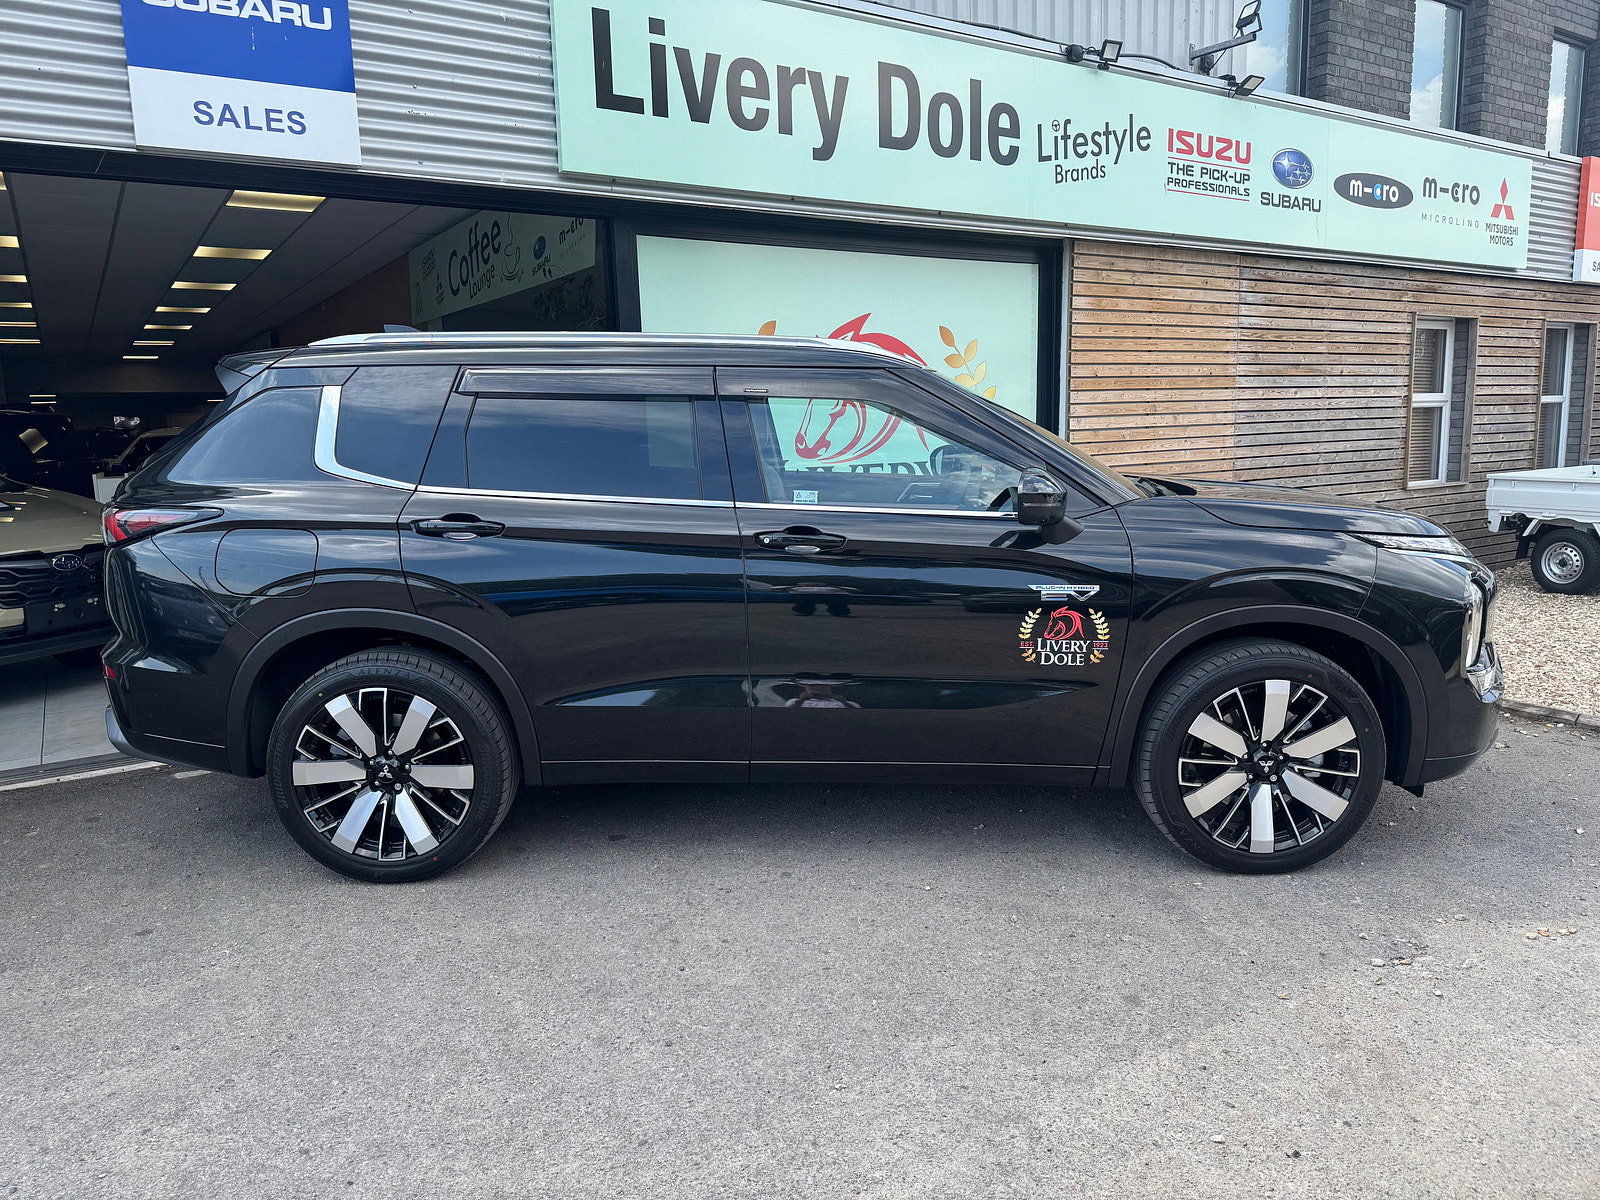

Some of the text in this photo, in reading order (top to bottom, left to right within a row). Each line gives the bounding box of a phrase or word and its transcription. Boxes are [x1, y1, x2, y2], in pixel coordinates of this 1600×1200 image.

[142, 0, 333, 31] BARU
[591, 6, 1021, 167] Livery Dole
[193, 100, 307, 136] SALES
[1037, 113, 1152, 165] Lifestyle
[1167, 127, 1252, 165] ISUZU
[1054, 158, 1106, 184] Brands
[1167, 161, 1251, 185] THE PICK-UP
[1167, 176, 1250, 197] PROFESSIONALS
[1260, 191, 1322, 213] SUBARU
[1421, 212, 1480, 229] MICROLINO
[1485, 222, 1519, 236] MITSUBISHI
[1489, 234, 1514, 247] MOTORS
[448, 219, 502, 297] Coffee
[468, 264, 496, 300] Lounge
[1036, 637, 1092, 653] LIVERY
[1040, 651, 1085, 666] DOLE
[358, 667, 411, 679] ALENZA
